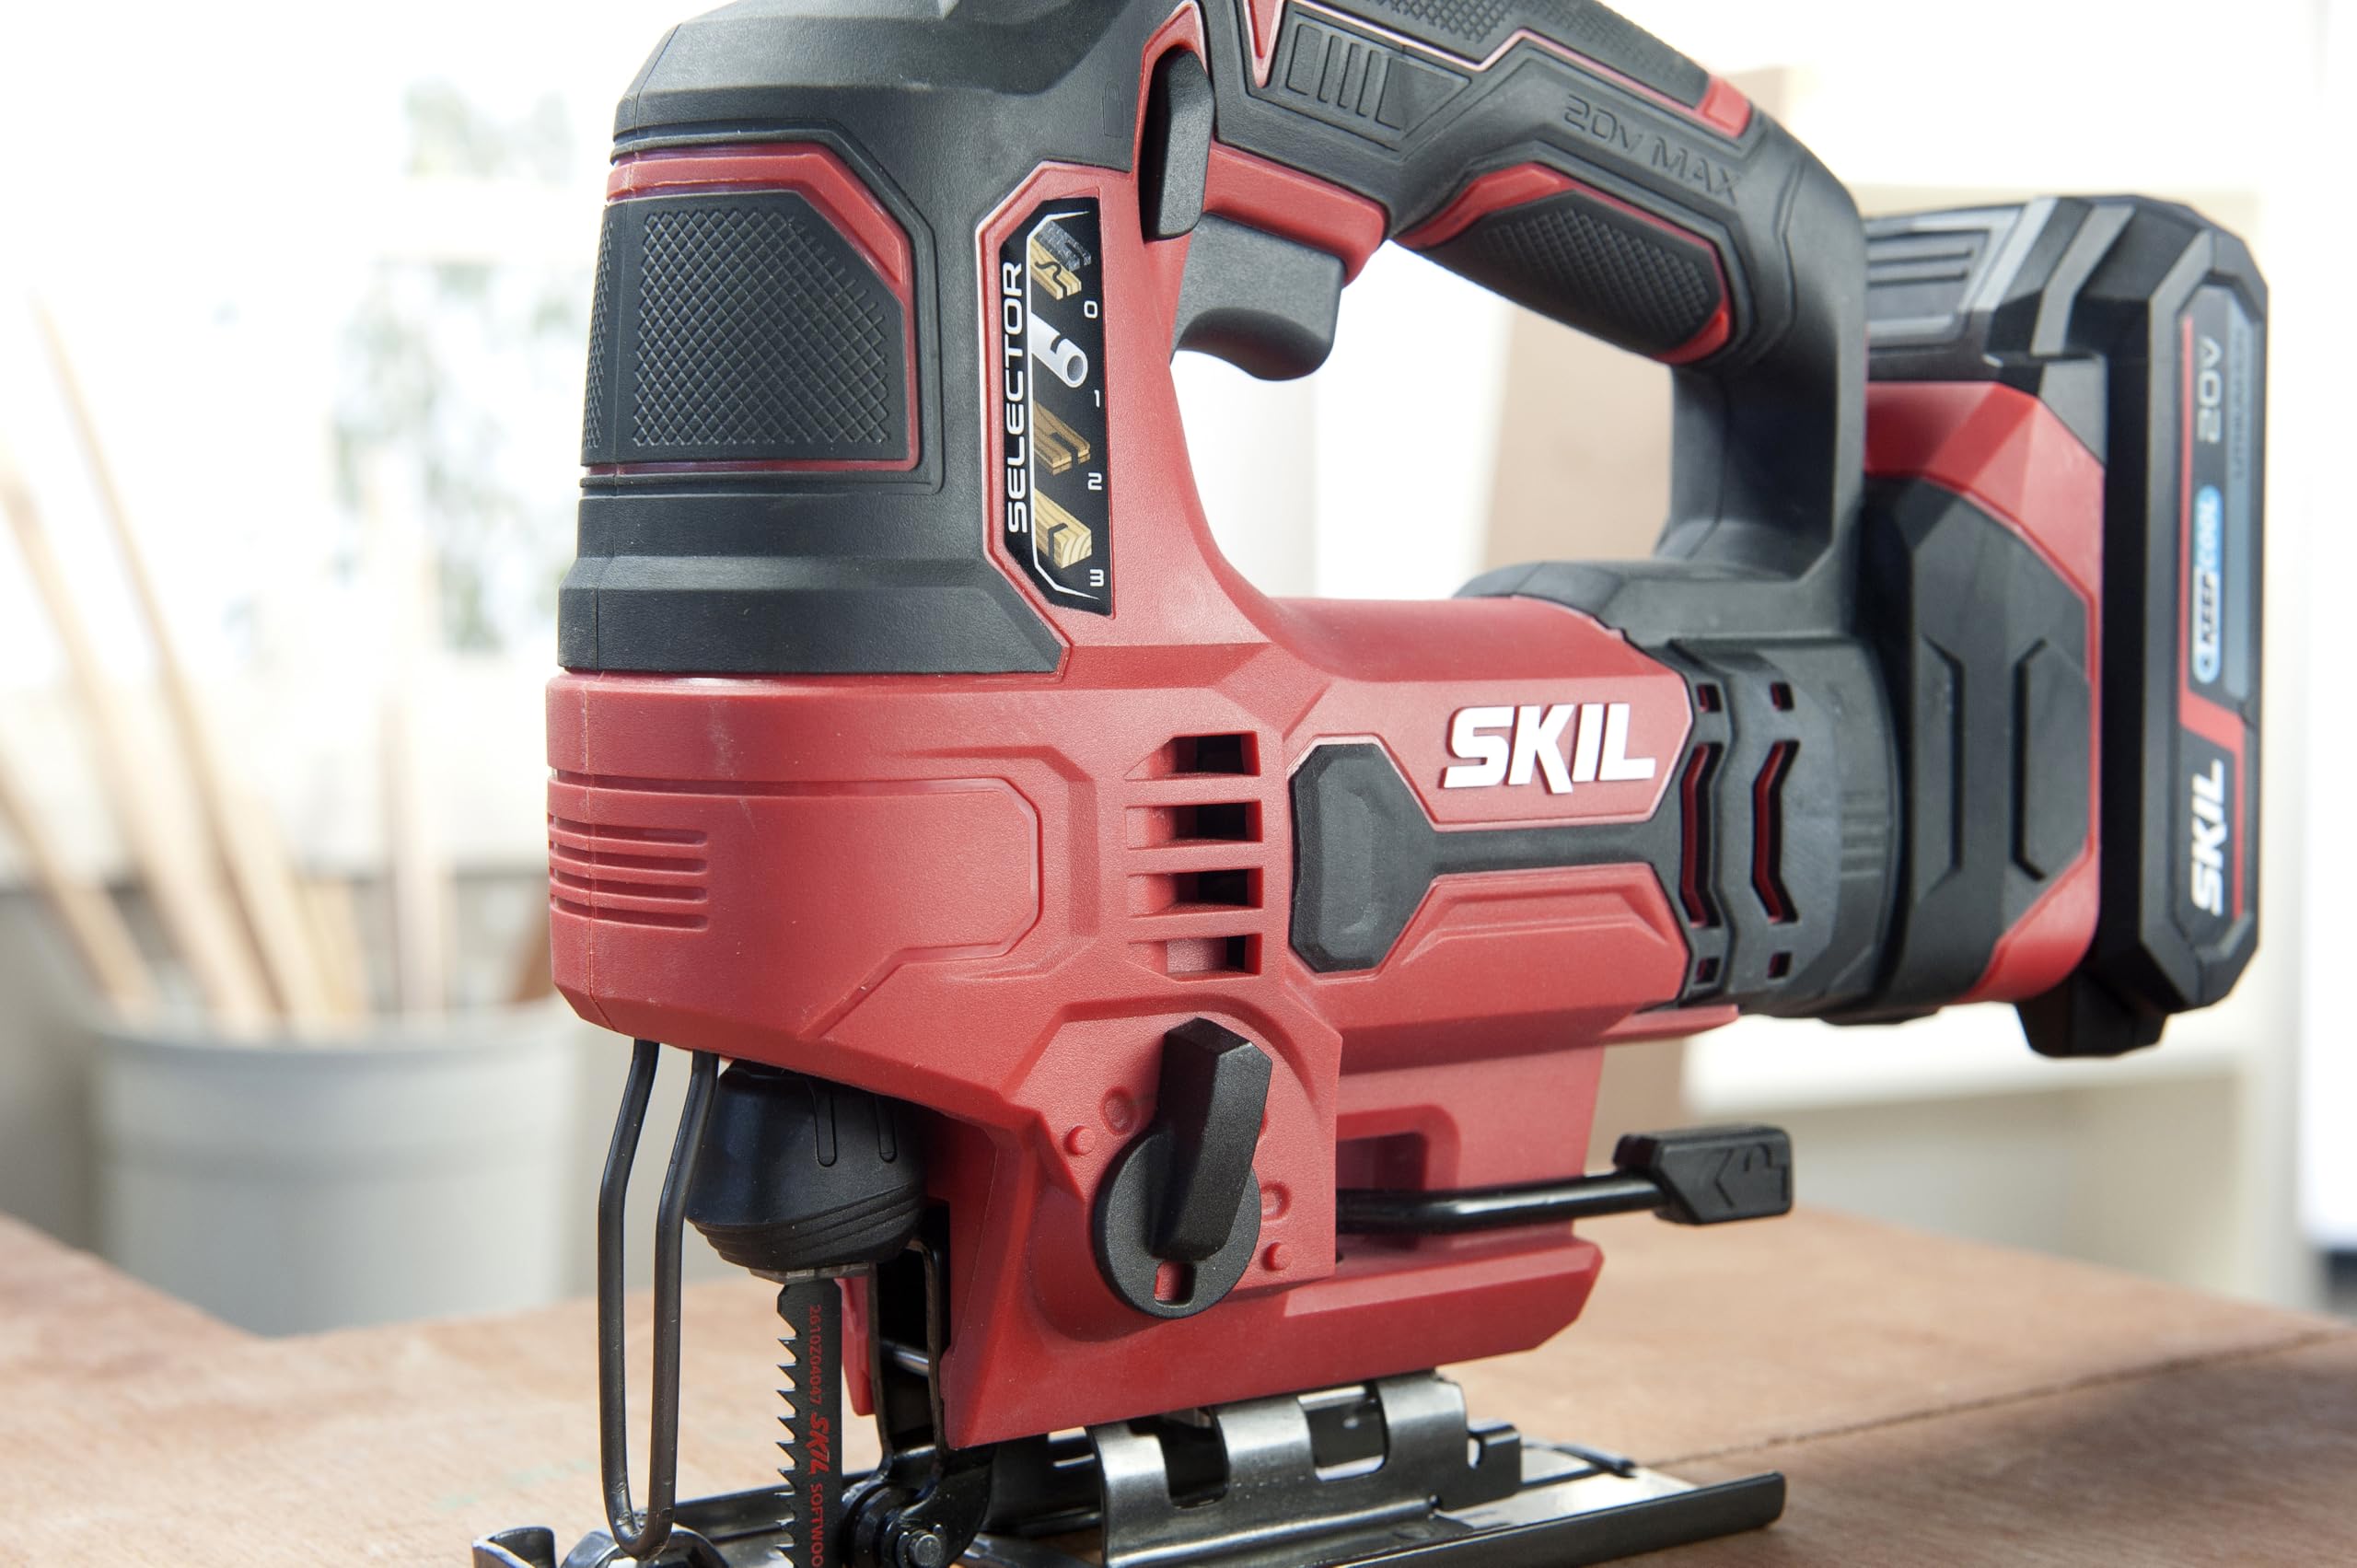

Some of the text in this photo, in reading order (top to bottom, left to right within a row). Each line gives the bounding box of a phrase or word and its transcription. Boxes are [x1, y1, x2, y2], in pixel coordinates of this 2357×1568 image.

[1564, 93, 1739, 205] 20V MAX
[1003, 261, 1028, 533] SELECTOR
[2197, 336, 2222, 445] 20V
[1087, 472, 1102, 491] 2
[1090, 569, 1105, 587] 3
[1442, 703, 1656, 795] SKIL
[2191, 758, 2227, 917] SKIL
[806, 1411, 830, 1475] SKIL
